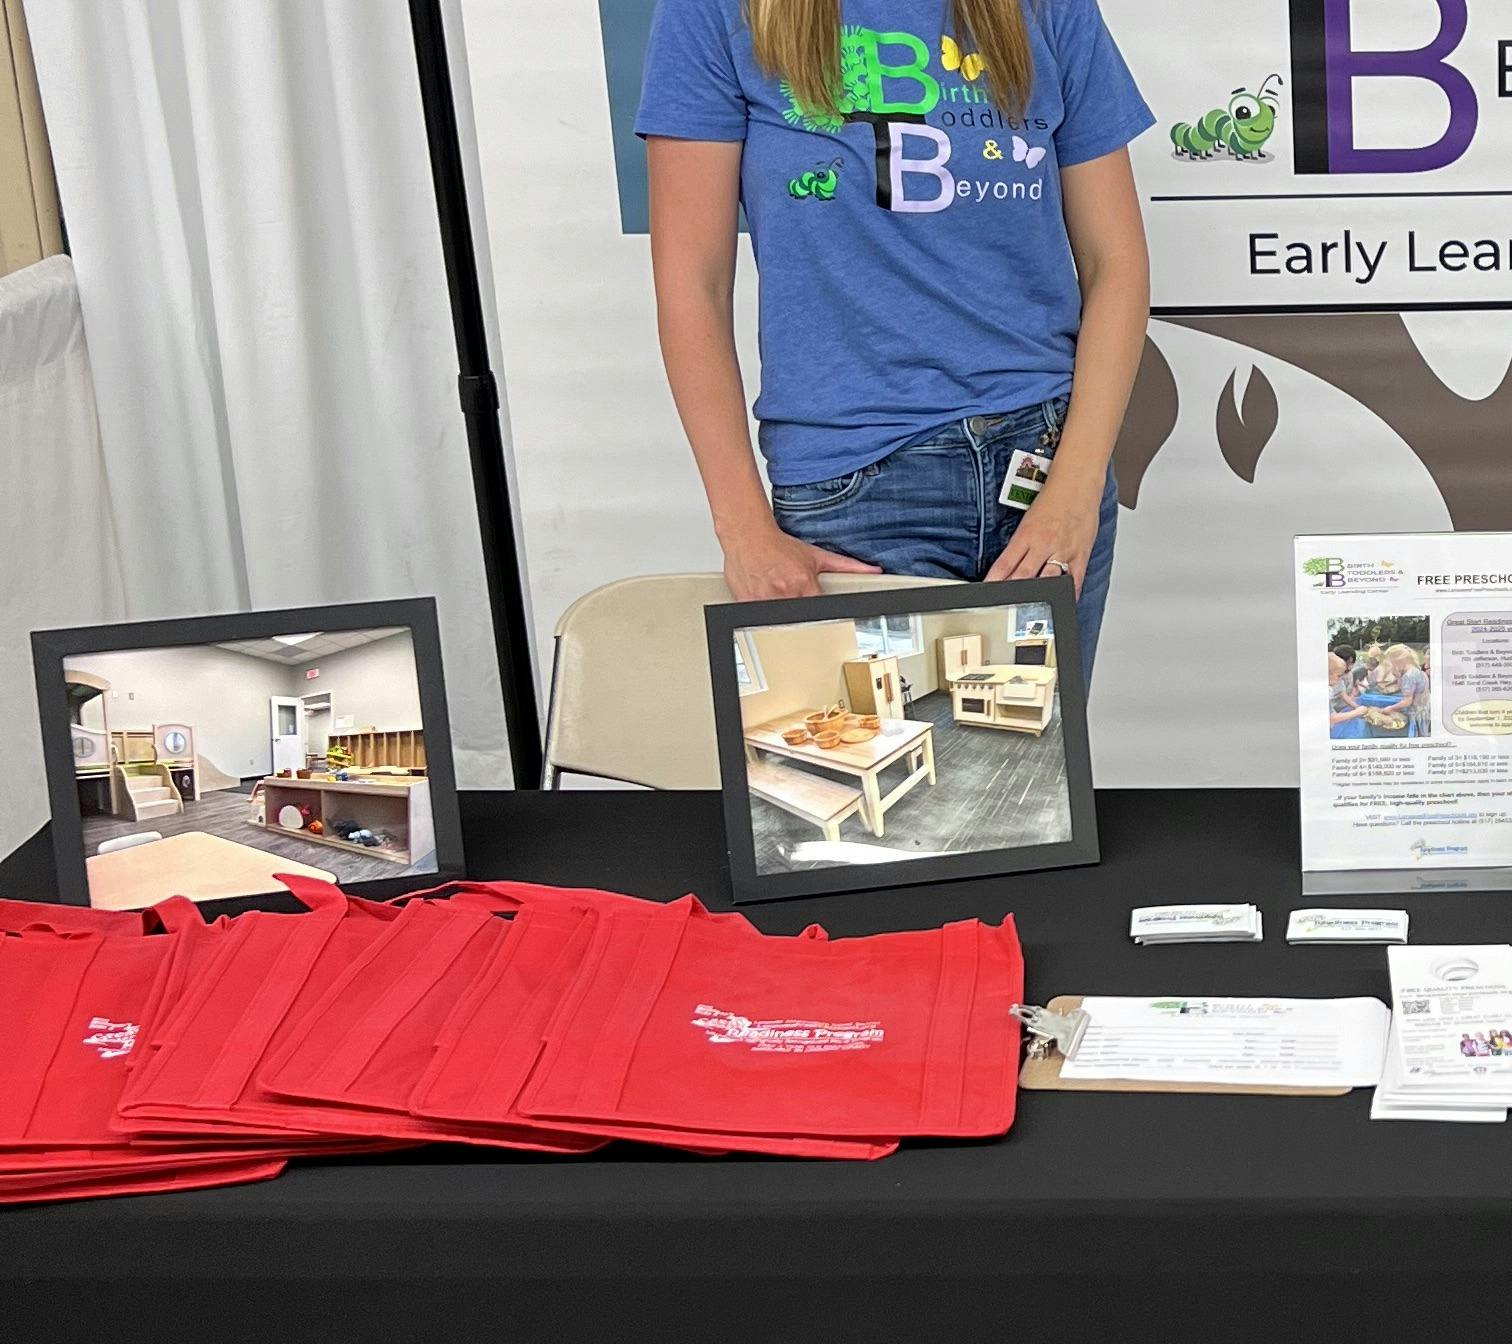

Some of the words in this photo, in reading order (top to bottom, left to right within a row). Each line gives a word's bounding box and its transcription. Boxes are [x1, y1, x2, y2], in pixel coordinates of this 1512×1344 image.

[982, 140, 1003, 160] &
[1248, 232, 1386, 284] Early
[1417, 575, 1451, 585] FREE
